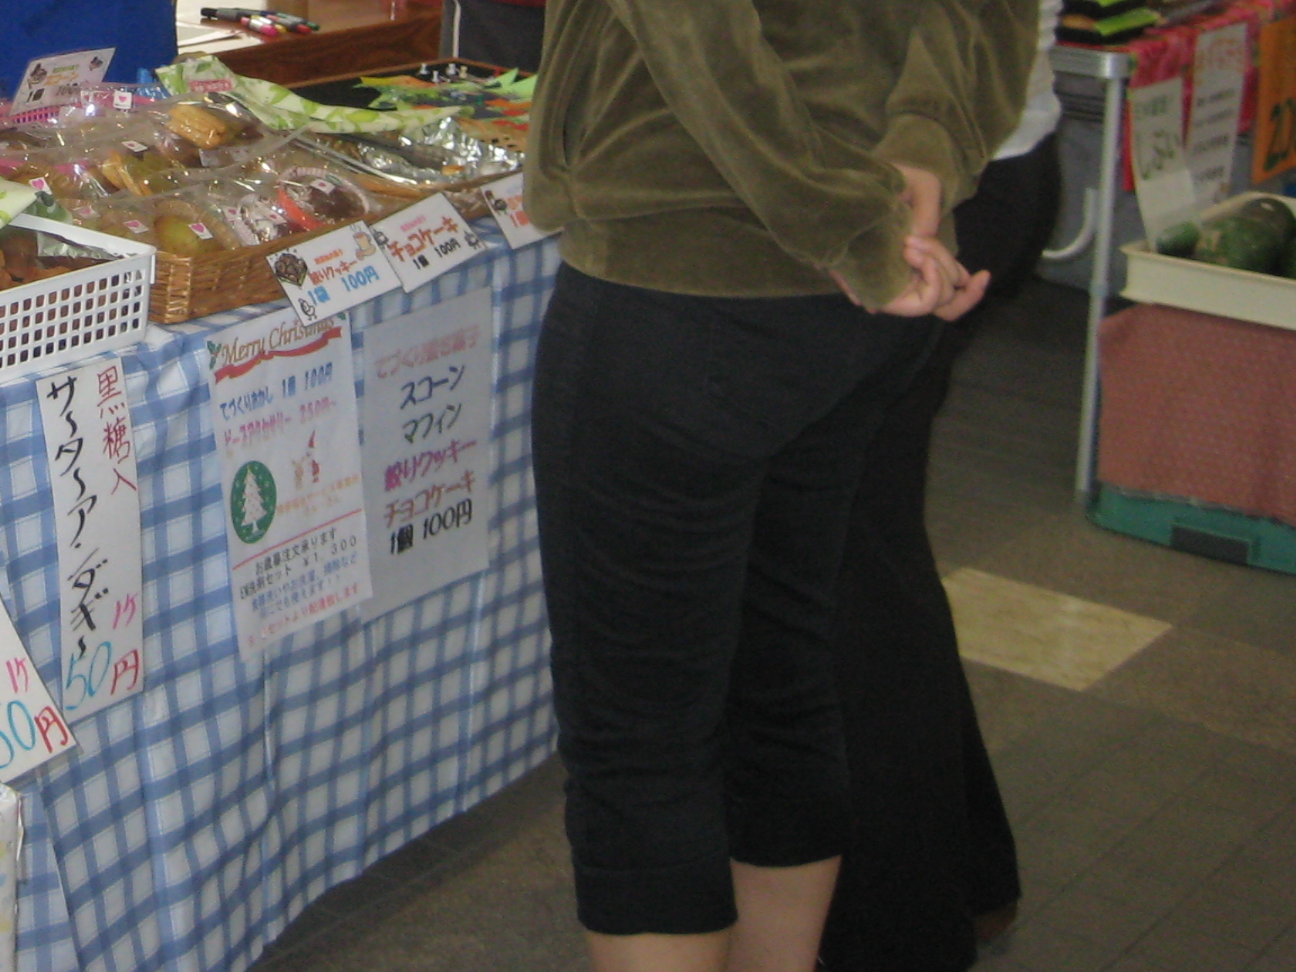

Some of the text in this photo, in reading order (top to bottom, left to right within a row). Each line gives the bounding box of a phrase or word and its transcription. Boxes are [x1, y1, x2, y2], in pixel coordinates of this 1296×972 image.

[387, 215, 459, 262] チョコケーキ
[433, 237, 461, 258] 100円
[341, 264, 380, 292] 100円
[222, 336, 266, 365] Merry
[399, 364, 465, 410] スコーン
[96, 365, 137, 496] 黒糖入
[402, 402, 462, 444] マフィン
[384, 469, 476, 529] チョコケーキ
[423, 498, 473, 539] 100円
[64, 640, 140, 712] 50円
